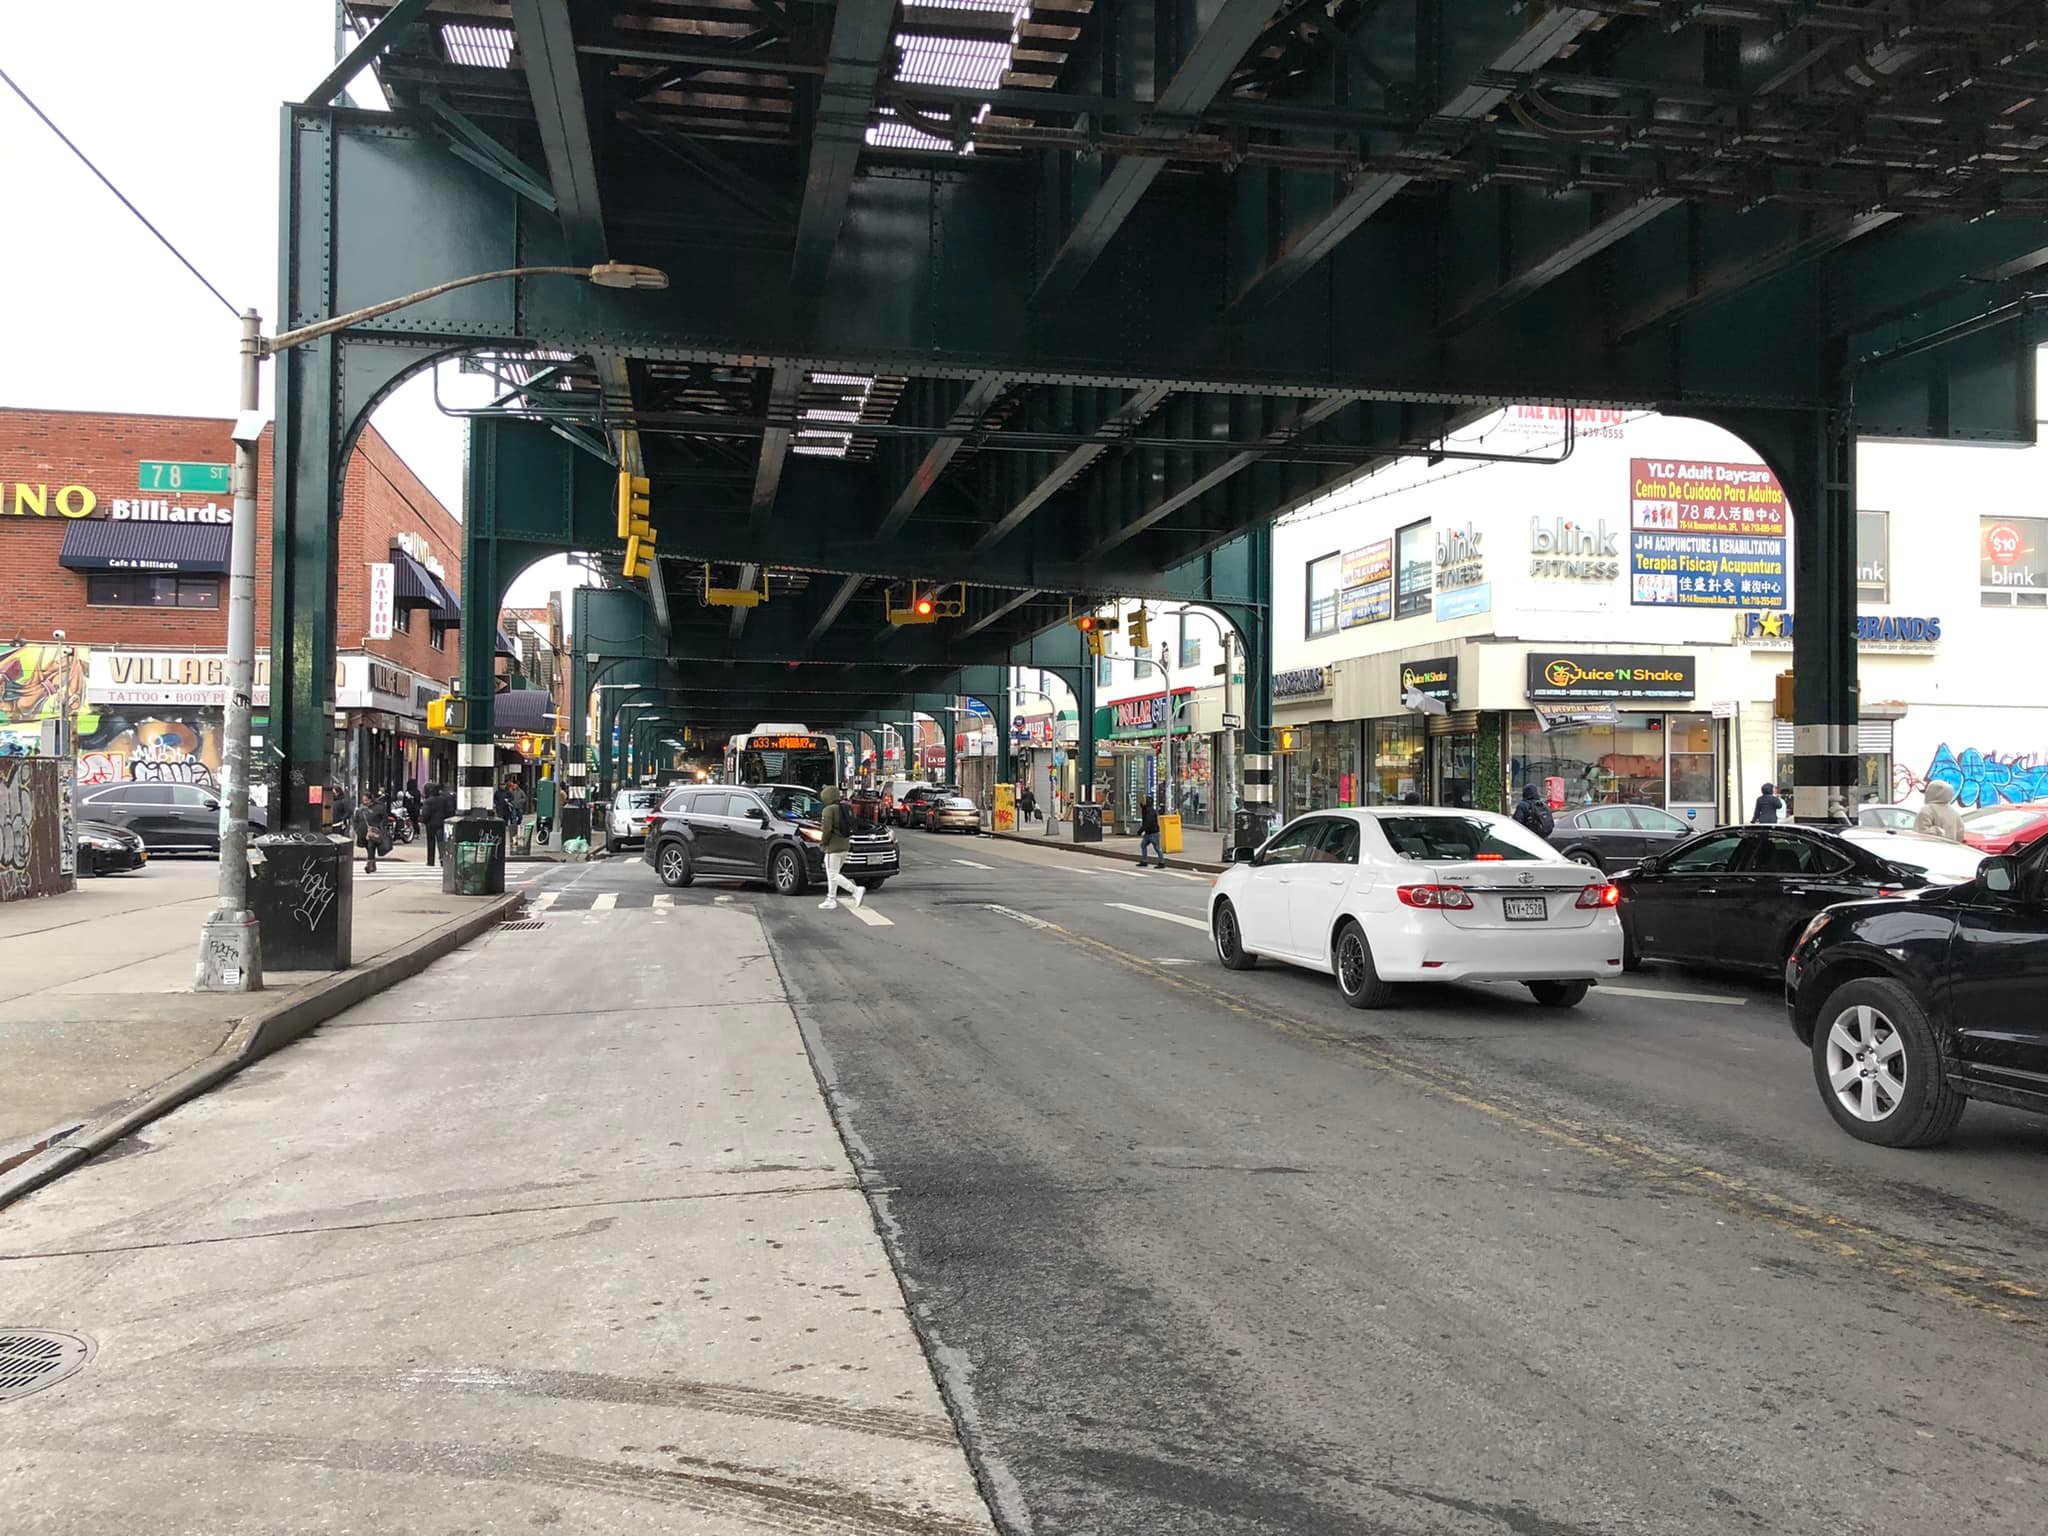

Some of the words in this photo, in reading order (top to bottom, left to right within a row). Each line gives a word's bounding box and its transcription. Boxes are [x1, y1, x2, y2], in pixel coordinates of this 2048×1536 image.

[152, 465, 182, 488] 78
[210, 467, 225, 479] ST
[1648, 463, 1674, 478] YLC
[1678, 464, 1713, 480] Adult
[1716, 466, 1770, 485] Daycare
[1635, 479, 1667, 498] Centro
[1669, 482, 1682, 499] De
[1683, 482, 1722, 501] Cuidado
[1724, 484, 1746, 502] Para
[1748, 485, 1782, 504] Adultos
[0, 482, 97, 518] NO
[112, 499, 232, 524] Billiards
[1680, 503, 1700, 520] 78
[1703, 505, 1781, 522] 成人活動中心
[1436, 522, 1481, 567] blink
[1530, 516, 1618, 557] blink
[1634, 535, 1653, 550] JH
[1655, 536, 1711, 553] ACUPUNCTURE
[1720, 539, 1781, 555] REHABILITATION
[1993, 538, 2017, 552] $10
[140, 560, 178, 569] Billiards
[1530, 559, 1620, 580] FITNESS
[1635, 553, 1677, 573] Terapia
[1679, 555, 1718, 576] Fisicay
[1720, 557, 1781, 576] Acupuntura
[1991, 565, 2035, 585] blink
[376, 567, 388, 634] TATTOO
[109, 656, 228, 686] VILLAG
[1569, 668, 1614, 681] Juice
[1633, 669, 1684, 681] Shake
[108, 691, 159, 702] TATTOO
[176, 692, 208, 703] BODY
[1118, 699, 1151, 726] DOLLAR
